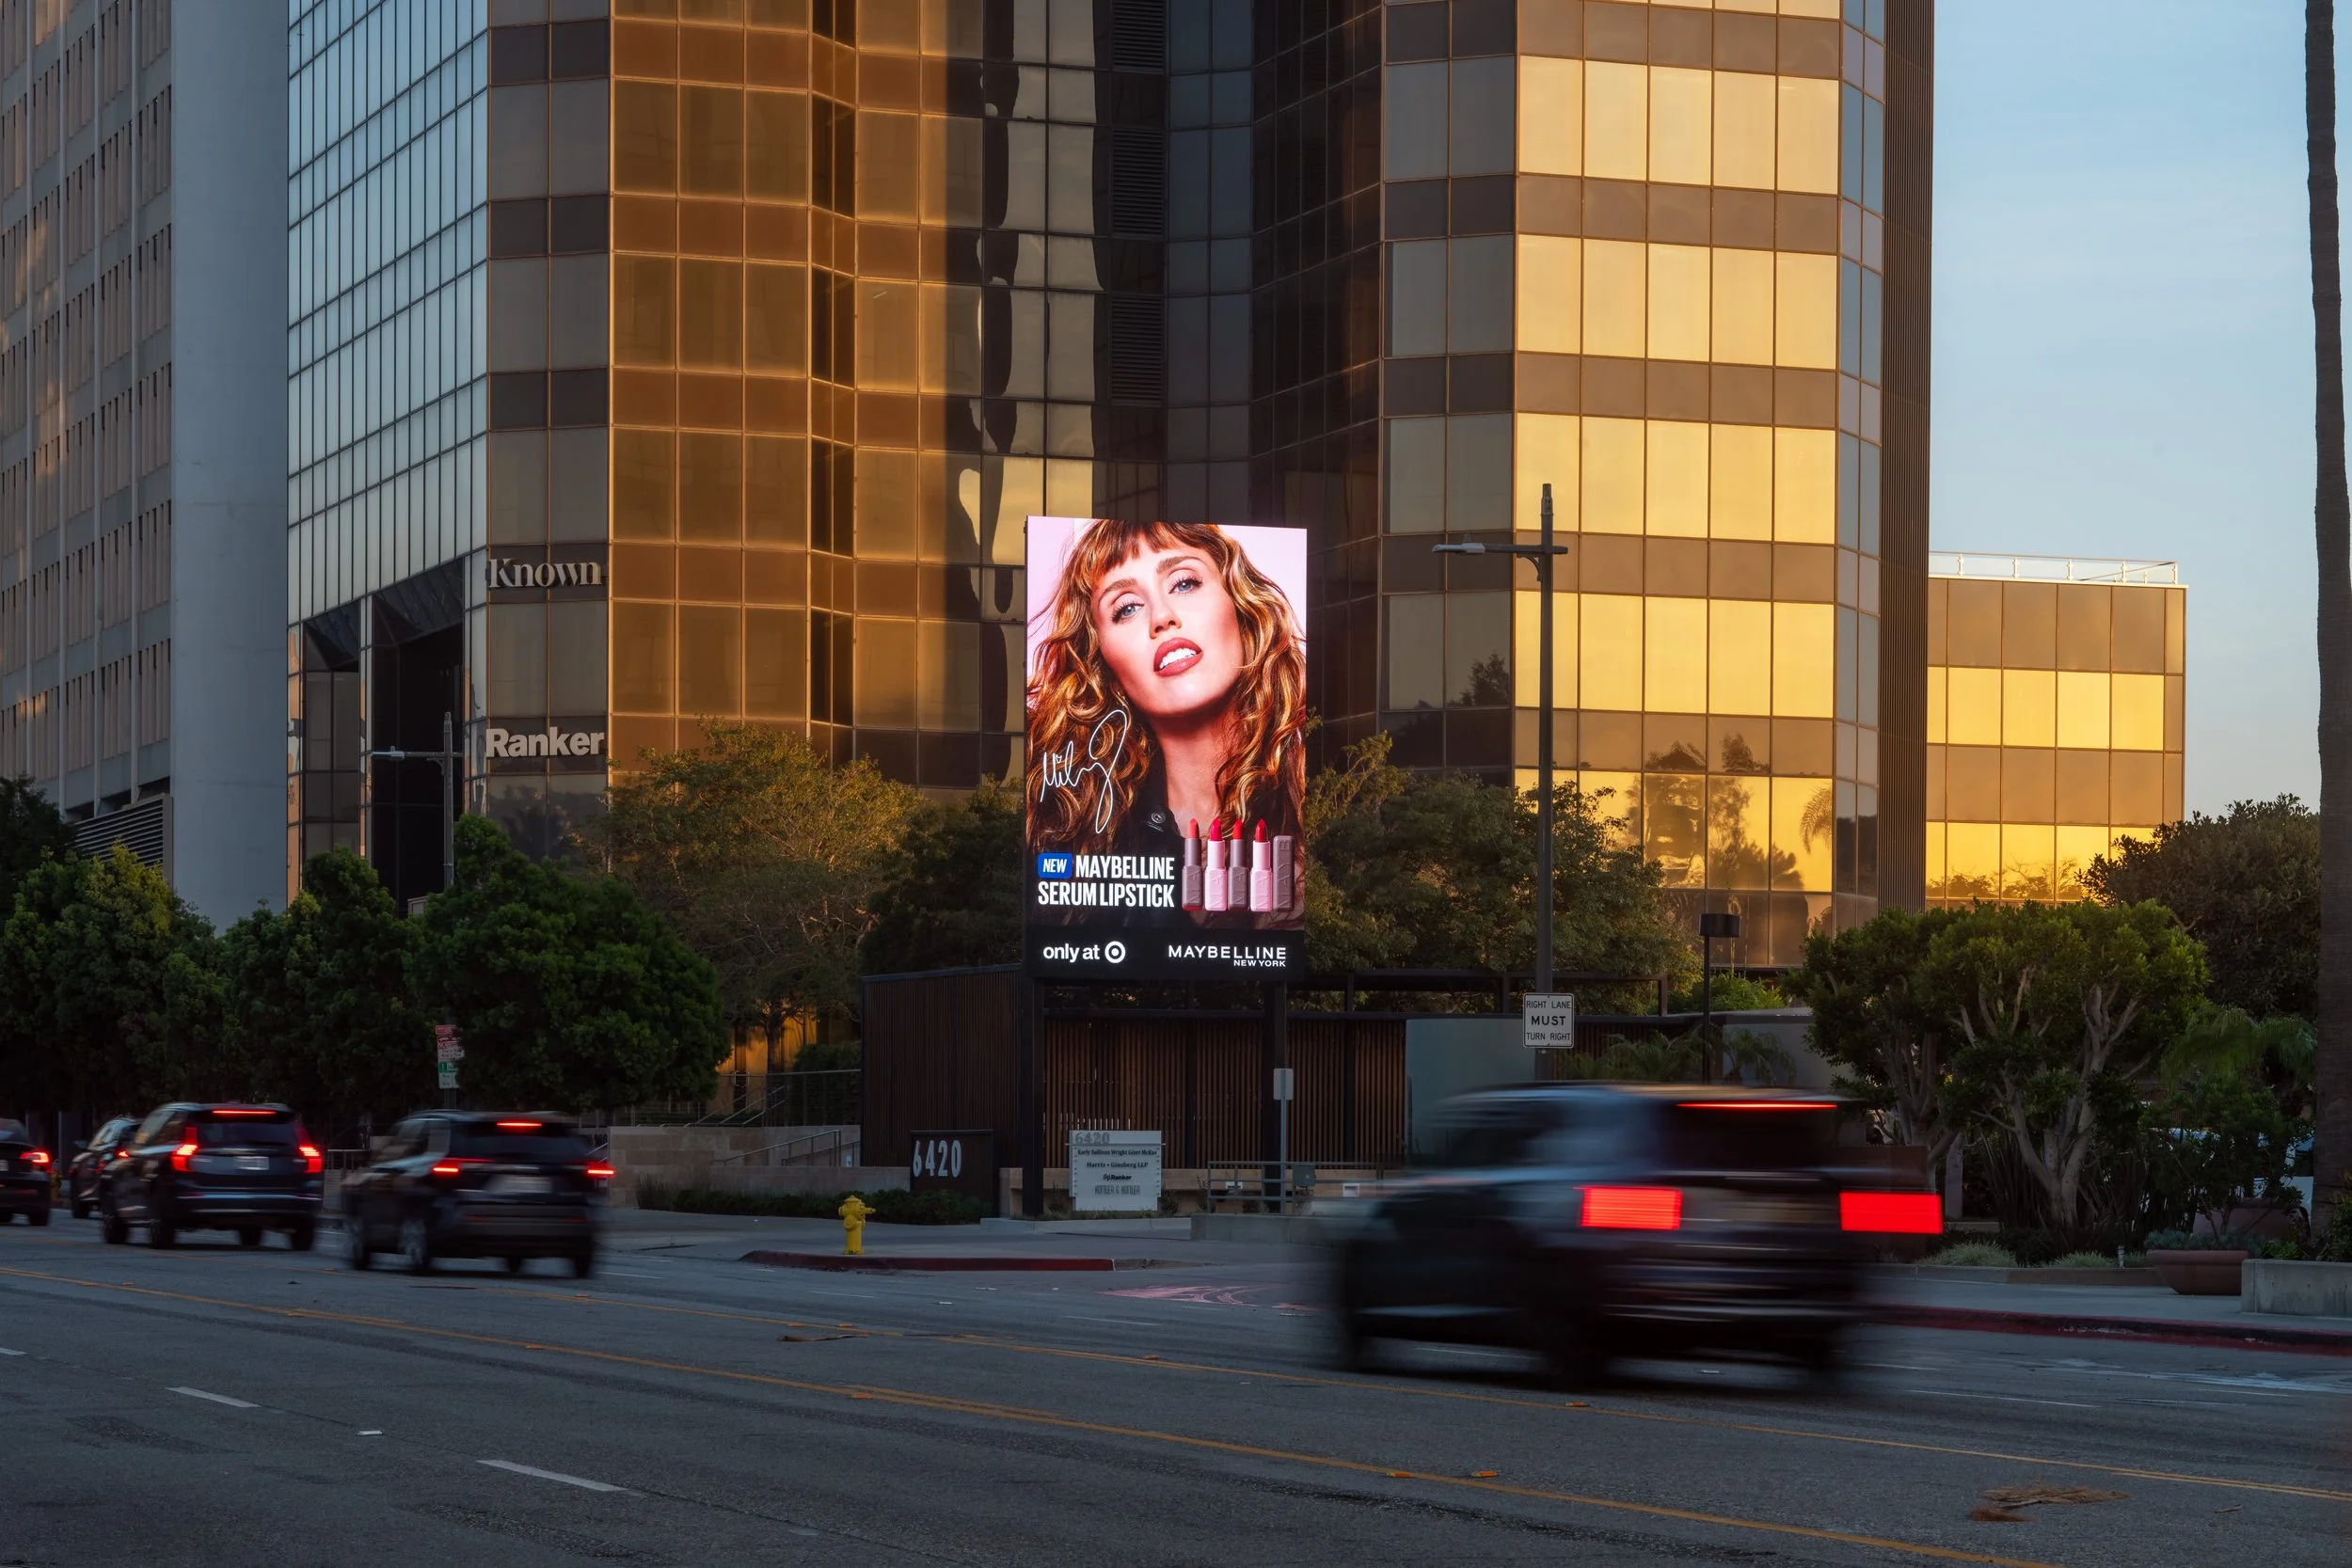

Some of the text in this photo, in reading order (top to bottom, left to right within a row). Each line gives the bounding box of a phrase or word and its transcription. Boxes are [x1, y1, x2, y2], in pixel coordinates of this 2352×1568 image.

[488, 558, 603, 588] Known
[485, 726, 605, 757] Ranker
[1042, 855, 1175, 880] NEW MAYBELLINE
[1038, 881, 1175, 908] SERUM LIPSTICK
[1043, 943, 1100, 963] only at
[1168, 945, 1286, 959] MAYBELLINE
[1532, 1016, 1565, 1025] MUST
[1075, 1132, 1110, 1145] 6420
[913, 1140, 961, 1178] 6420
